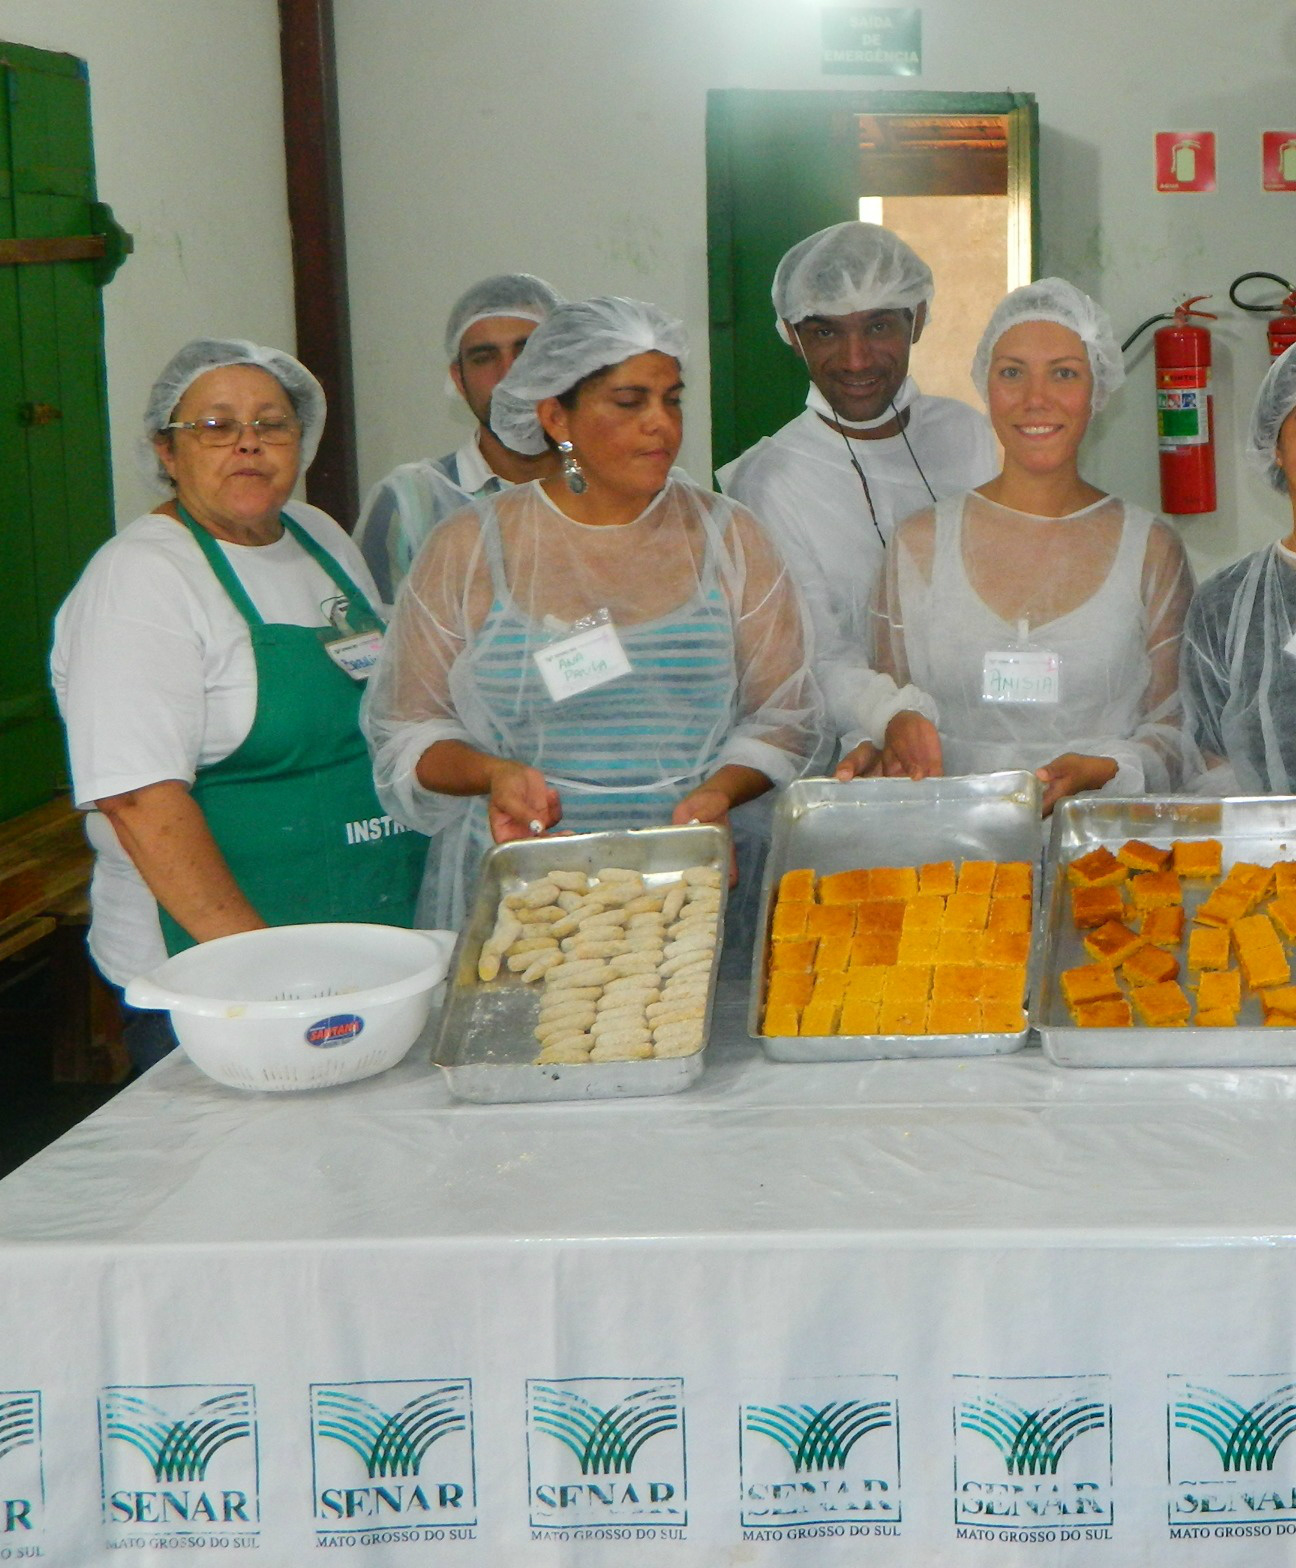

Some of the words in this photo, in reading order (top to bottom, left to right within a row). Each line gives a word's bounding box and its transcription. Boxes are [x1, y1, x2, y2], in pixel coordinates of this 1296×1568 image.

[110, 1490, 250, 1523] SENAR
[321, 1483, 465, 1519] SENAR
[535, 1482, 680, 1516] SENAR
[961, 1481, 1104, 1516] SENAR
[316, 1535, 356, 1548] MATO
[361, 1531, 419, 1546] GROSSO
[425, 1530, 445, 1541] DO
[450, 1528, 477, 1540] SUL
[532, 1530, 569, 1541] MATO
[573, 1529, 631, 1540] GROSSO
[636, 1529, 655, 1540] DO
[661, 1530, 687, 1540] SUL
[742, 1528, 782, 1541] MATO
[787, 1527, 845, 1539] GROSSO
[850, 1526, 870, 1537] DO
[875, 1526, 901, 1537] SUL
[957, 1528, 994, 1540] MATO
[999, 1530, 1055, 1543] GROSSO
[1061, 1530, 1080, 1541] DO
[1085, 1528, 1112, 1540] SUL
[1170, 1527, 1210, 1539] MATO
[1214, 1526, 1271, 1537] GROSSO
[1276, 1525, 1296, 1535] DO
[106, 1537, 145, 1549] MATO
[149, 1537, 205, 1549] GROSSO
[210, 1537, 230, 1549] DO
[234, 1537, 260, 1549] SUL
